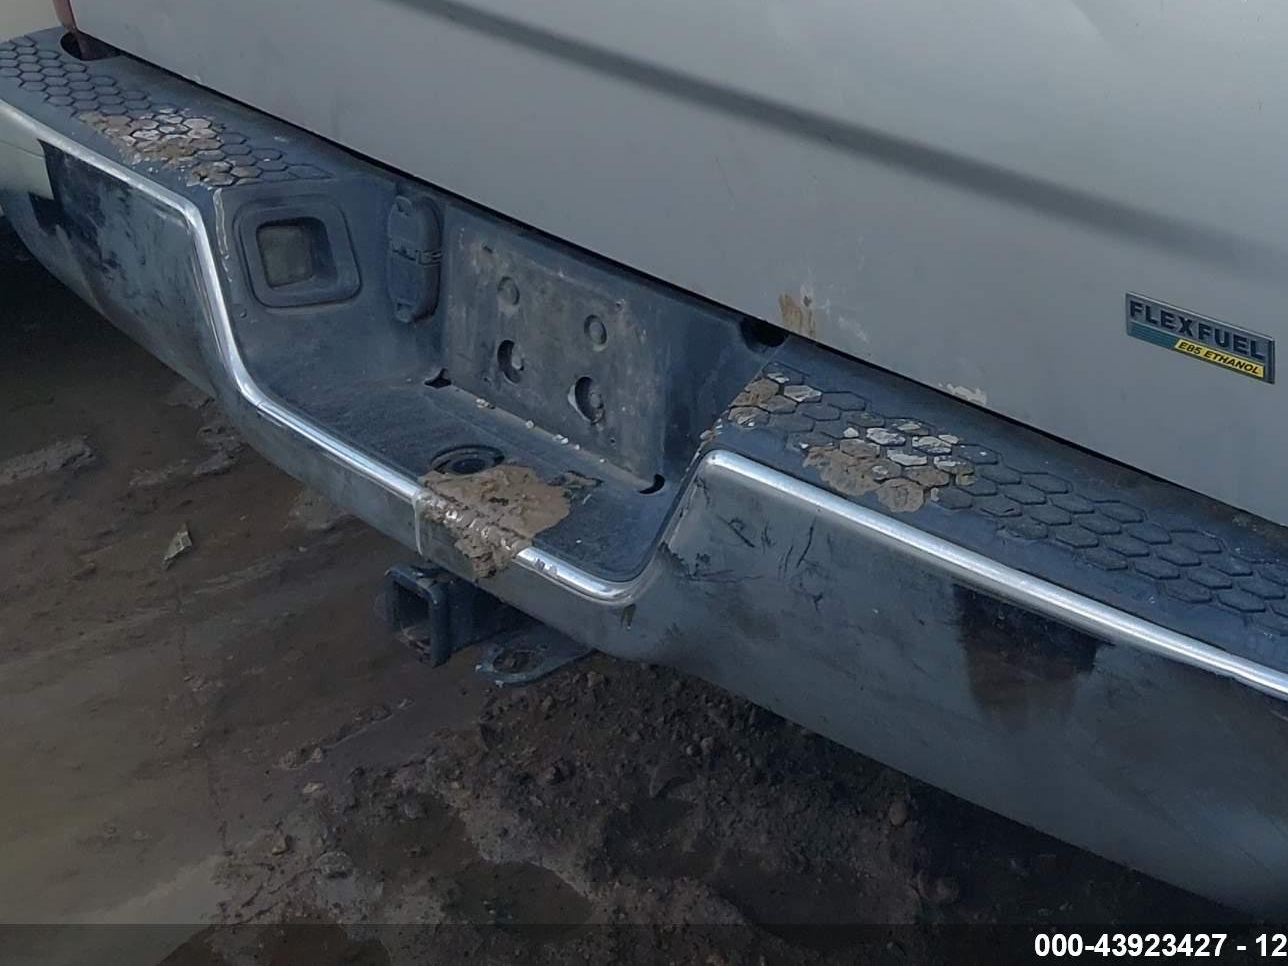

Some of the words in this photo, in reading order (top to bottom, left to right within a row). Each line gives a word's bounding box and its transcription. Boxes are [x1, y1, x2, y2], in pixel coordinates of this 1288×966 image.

[1130, 299, 1266, 360] FLEXFUEL
[1178, 340, 1202, 355] E85
[1204, 349, 1260, 375] ETHANOL
